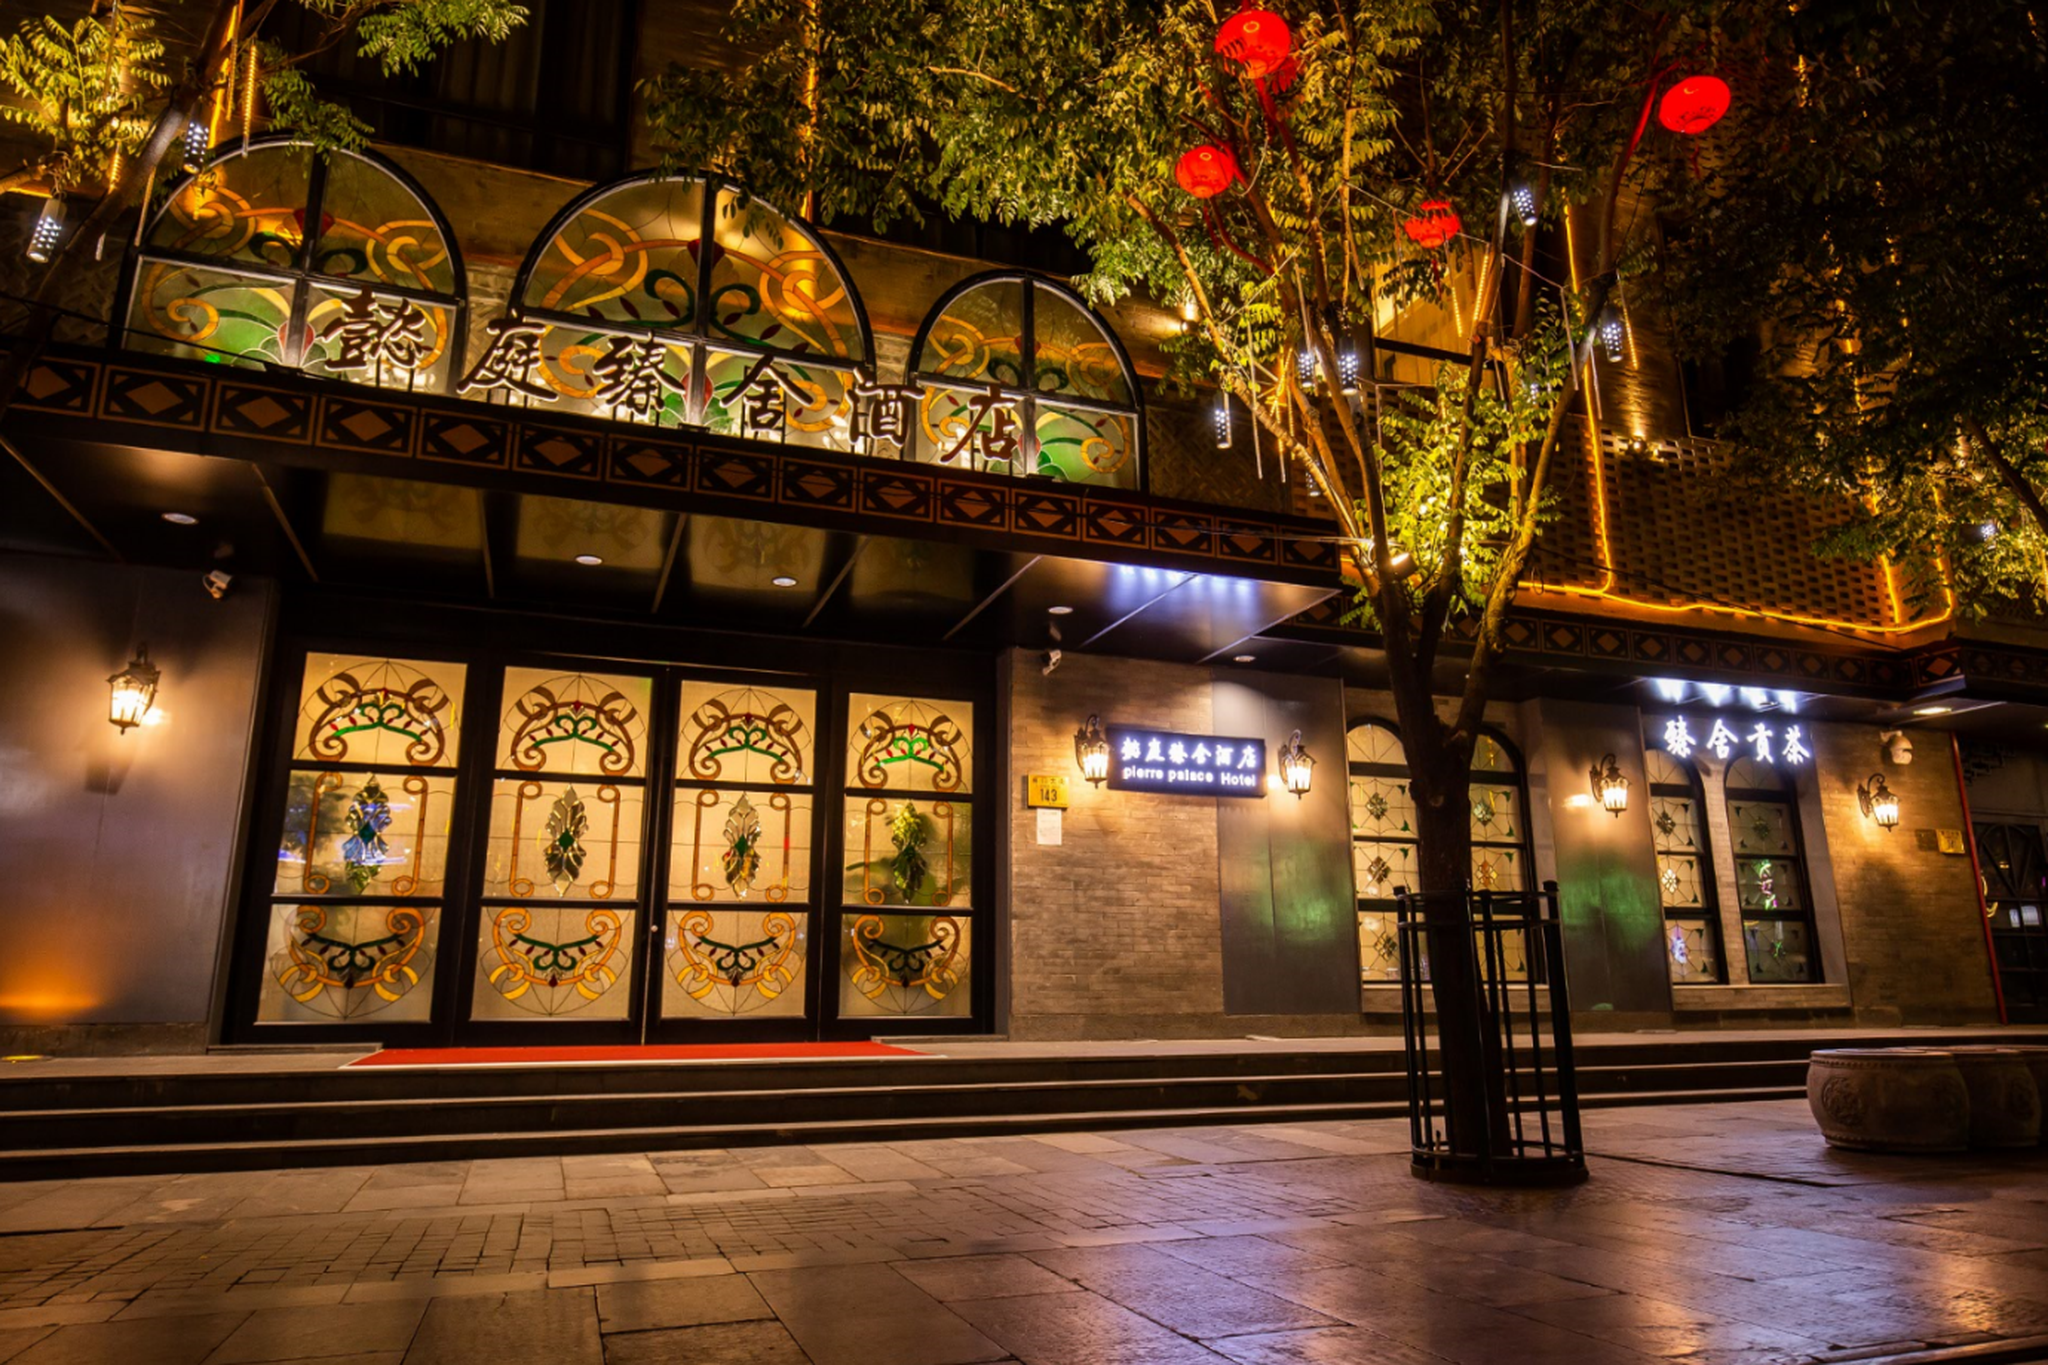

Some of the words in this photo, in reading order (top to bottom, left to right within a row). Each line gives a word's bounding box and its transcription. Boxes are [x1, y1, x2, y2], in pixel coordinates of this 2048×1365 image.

[319, 285, 1019, 463] 懿庭臻舍酒店
[1123, 766, 1164, 780] pierre
[1168, 769, 1214, 782] palace
[1221, 772, 1256, 786] Hotel
[1040, 788, 1058, 802] 143
